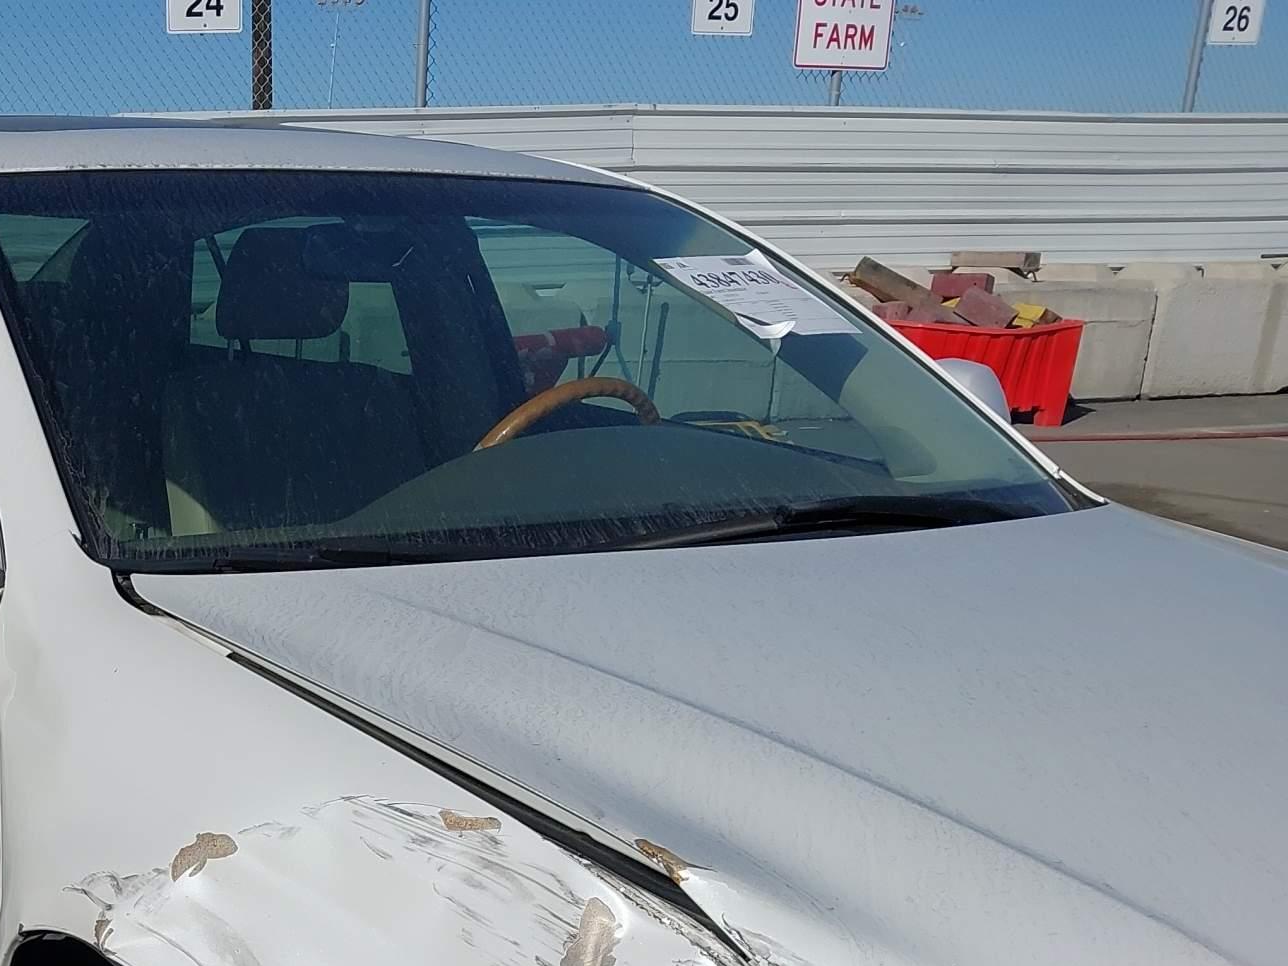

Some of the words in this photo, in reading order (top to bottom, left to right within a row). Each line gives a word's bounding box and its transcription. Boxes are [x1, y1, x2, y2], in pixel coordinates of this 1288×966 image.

[185, 0, 224, 17] 24
[707, 0, 739, 21] 25
[1222, 5, 1251, 32] 26
[813, 22, 875, 51] FARM
[690, 268, 780, 289] 43847430
